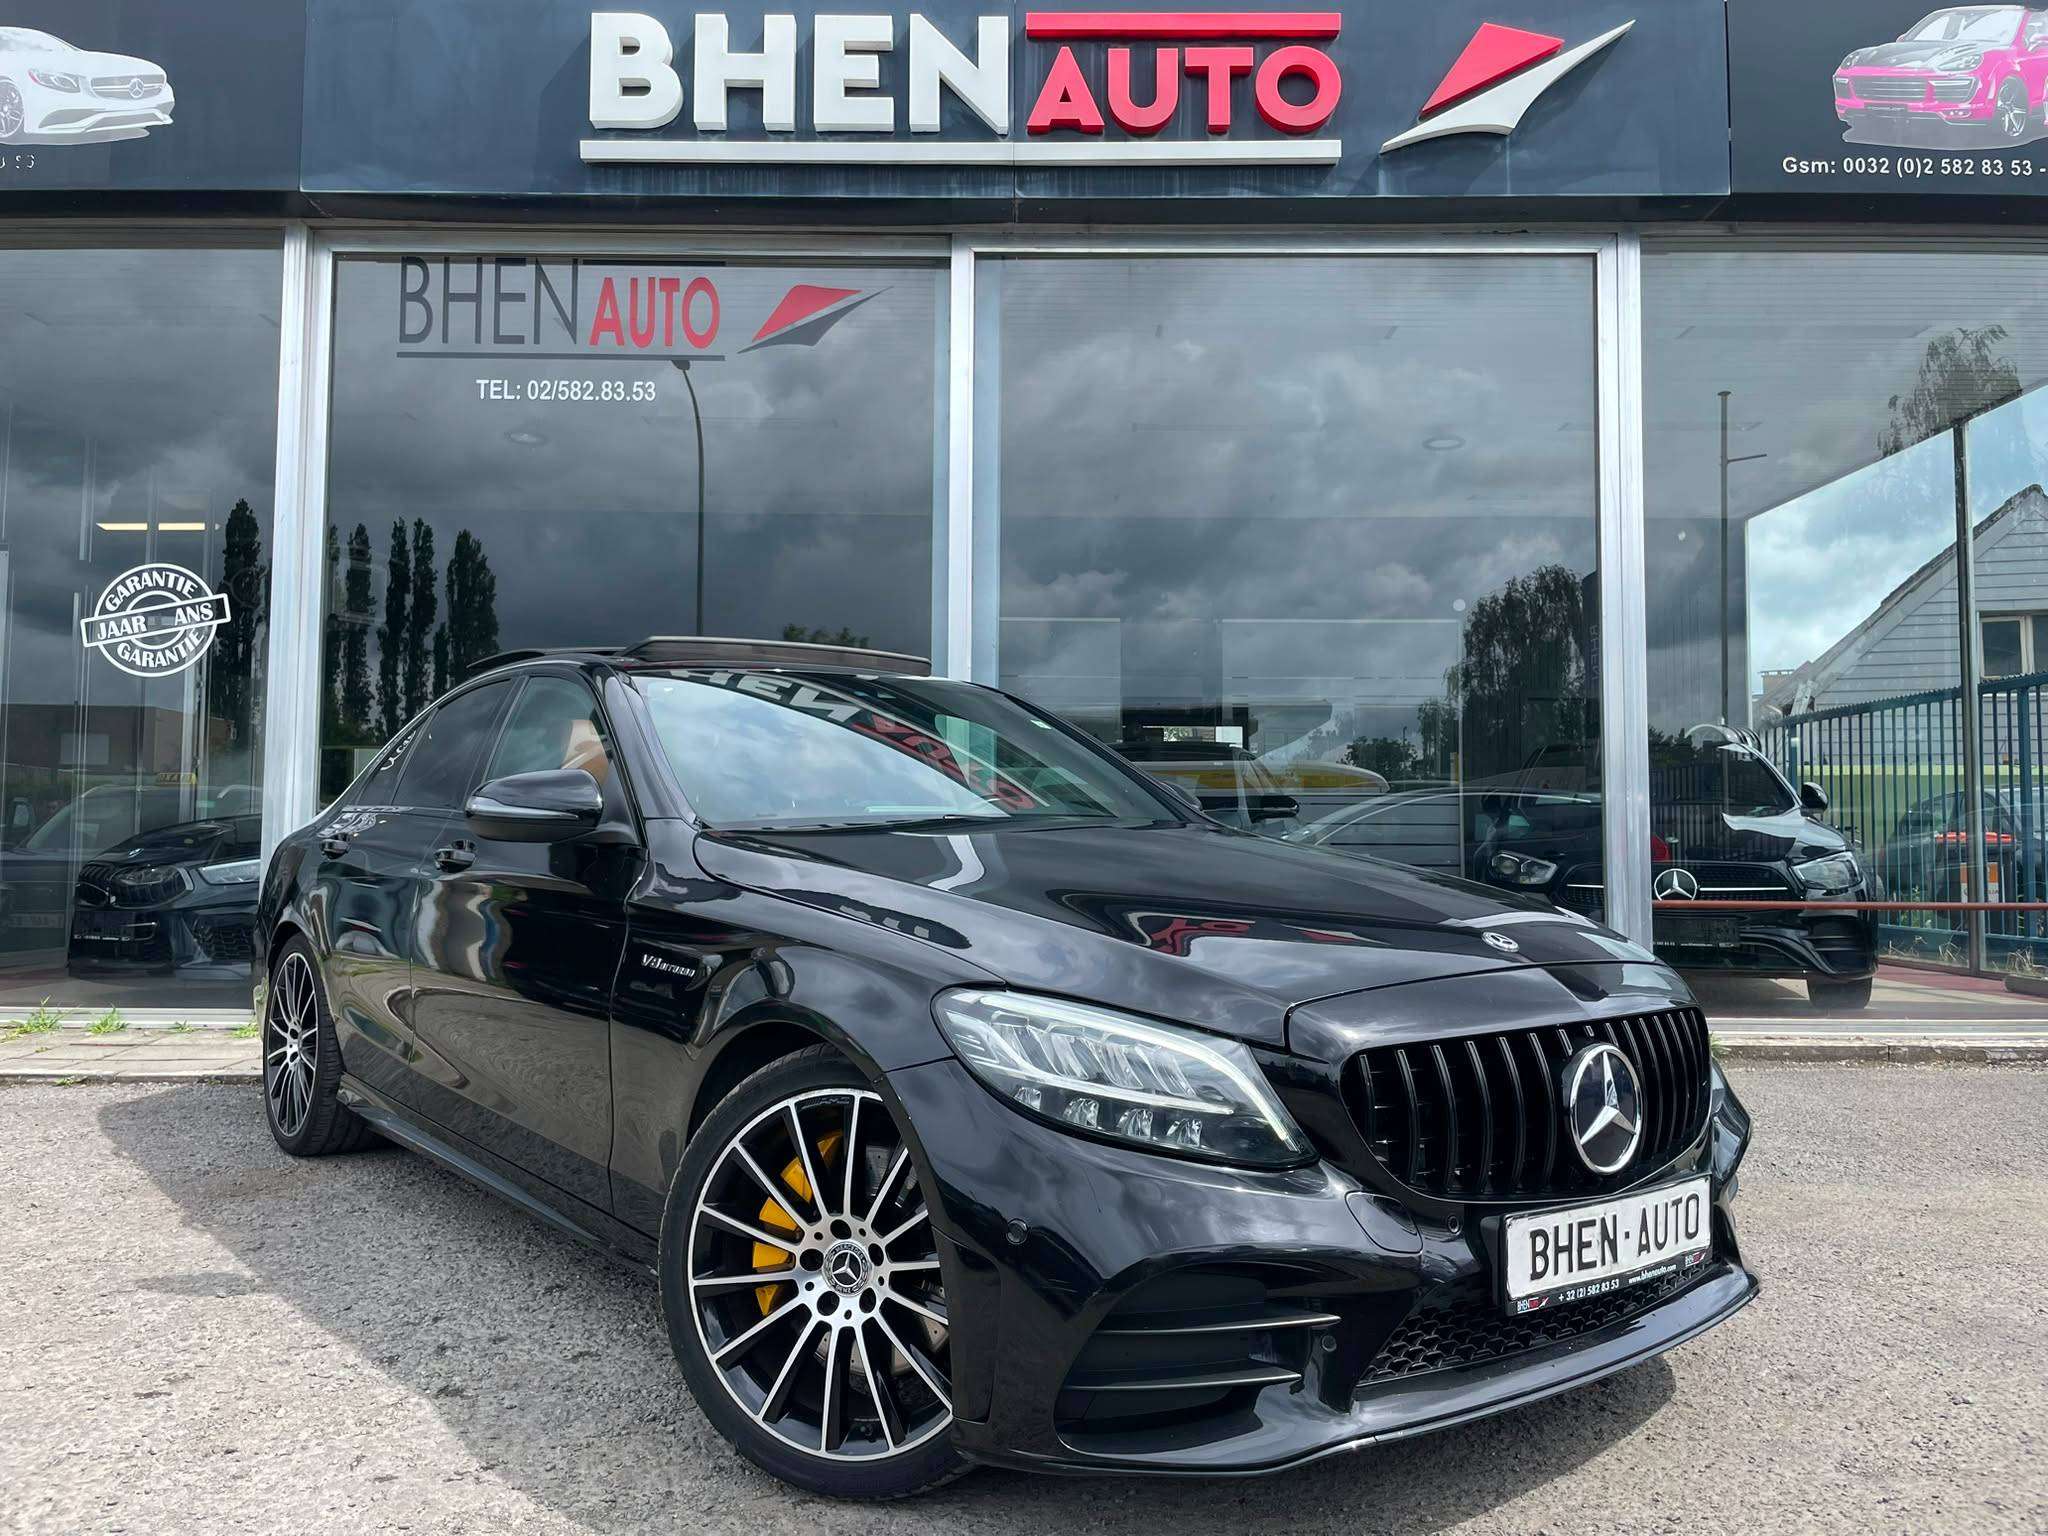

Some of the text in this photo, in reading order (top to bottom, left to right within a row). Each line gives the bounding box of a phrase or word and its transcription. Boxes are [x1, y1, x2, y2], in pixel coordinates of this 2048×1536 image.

[590, 12, 1342, 134] BHEN AUTO
[1782, 157, 1836, 174] Gsm:
[1843, 157, 1890, 174] 0032
[1897, 157, 1934, 178] (0)2
[1940, 158, 1975, 175] 582
[1981, 159, 2004, 175] 83
[2010, 159, 2033, 176] 53
[399, 256, 721, 349] BHEN AUTO
[476, 379, 656, 401] TEL: 02/582.83.53
[105, 570, 198, 611] GARANTIE
[97, 602, 214, 640] JAAR ANS
[117, 628, 204, 668] GARANTIE
[1529, 1214, 1619, 1281] BHEN
[1637, 1193, 1700, 1257] AUTO
[1566, 1289, 1576, 1301] 32
[1576, 1286, 1586, 1299] (2)
[1587, 1283, 1600, 1296] 582
[1600, 1281, 1610, 1292] 83
[1610, 1278, 1619, 1290] 53
